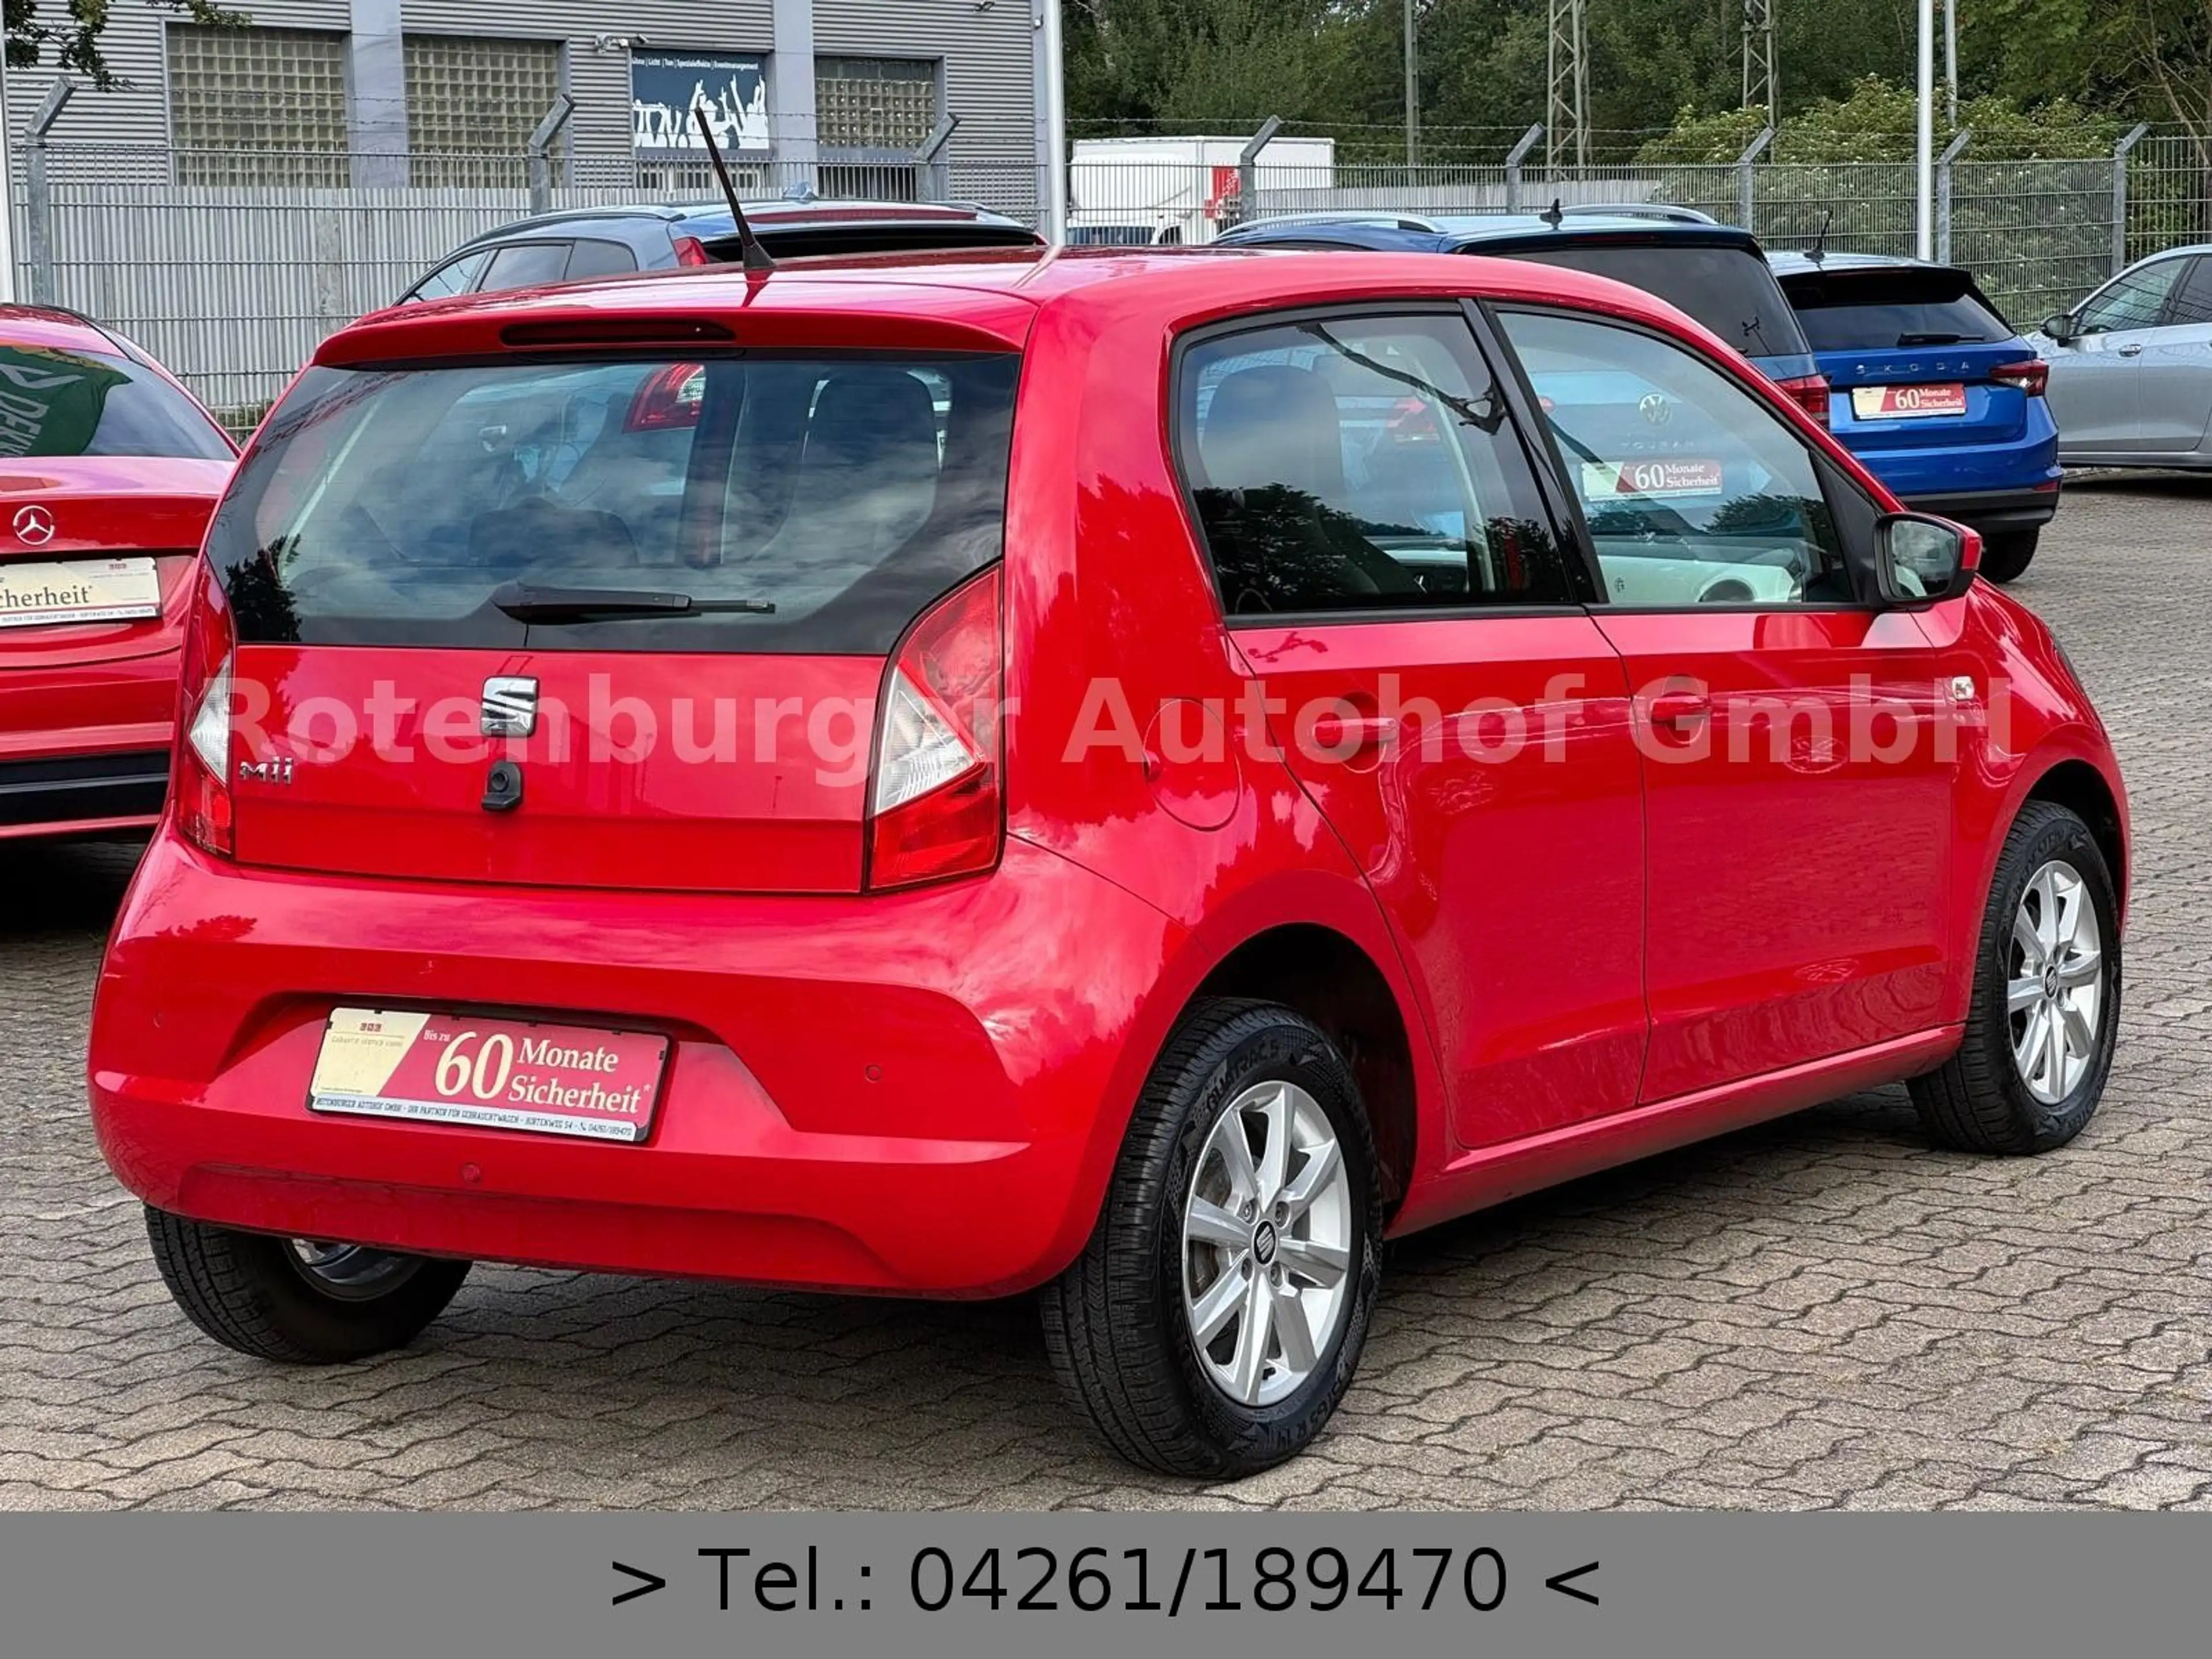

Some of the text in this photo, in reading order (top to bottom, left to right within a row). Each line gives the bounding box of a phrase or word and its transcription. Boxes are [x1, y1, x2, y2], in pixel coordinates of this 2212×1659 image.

[1895, 389, 1919, 409] 60
[1635, 464, 1664, 489] 60
[1665, 463, 1705, 474] Monate
[423, 1029, 450, 1042] Bis zu
[435, 1031, 513, 1100] 60
[517, 1037, 619, 1072] Monate
